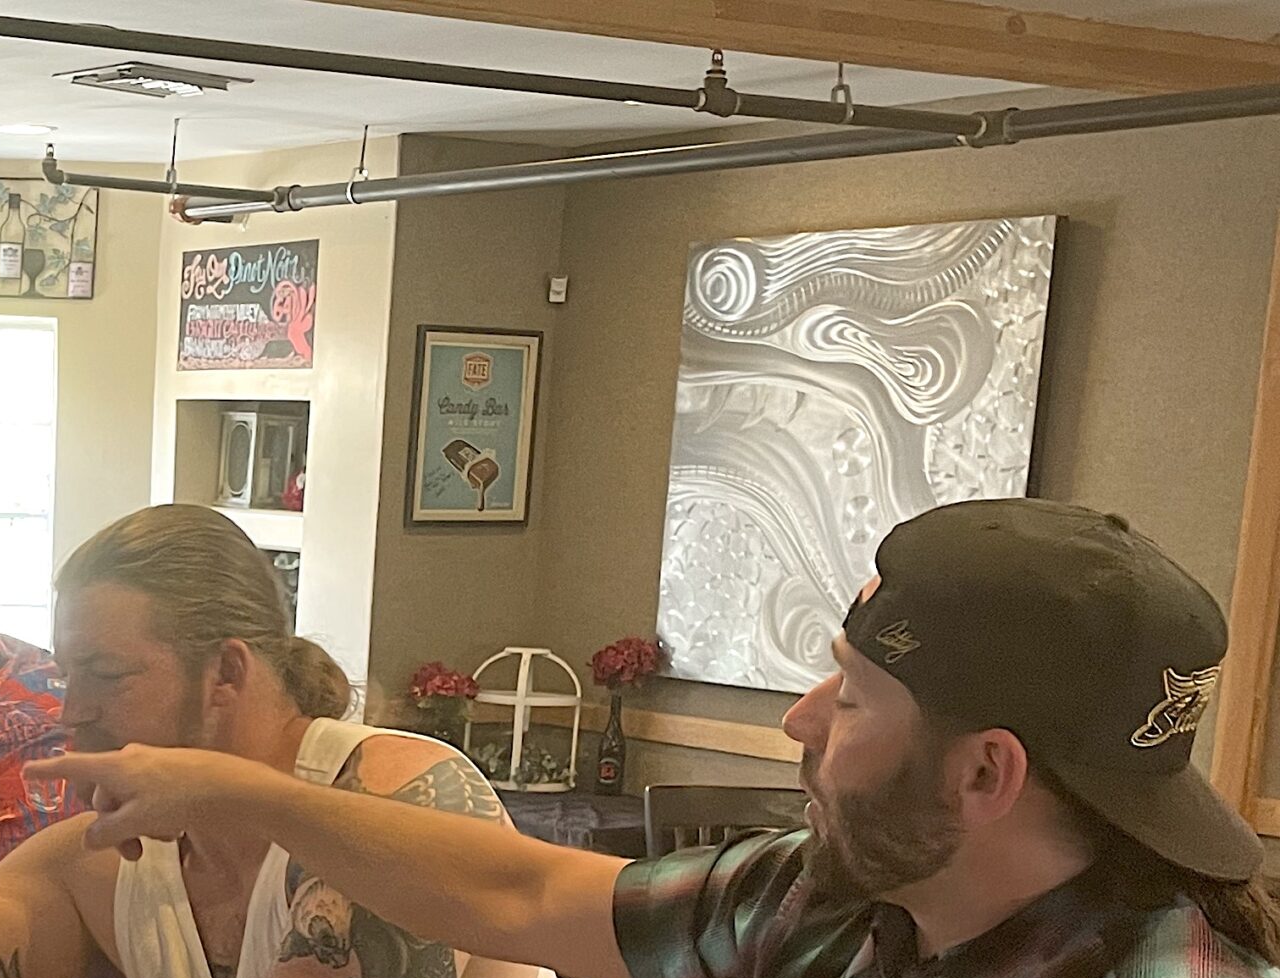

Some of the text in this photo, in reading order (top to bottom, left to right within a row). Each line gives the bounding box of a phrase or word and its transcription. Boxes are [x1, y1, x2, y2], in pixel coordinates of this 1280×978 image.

[468, 364, 487, 377] FATE
[437, 396, 509, 420] Candy Bar
